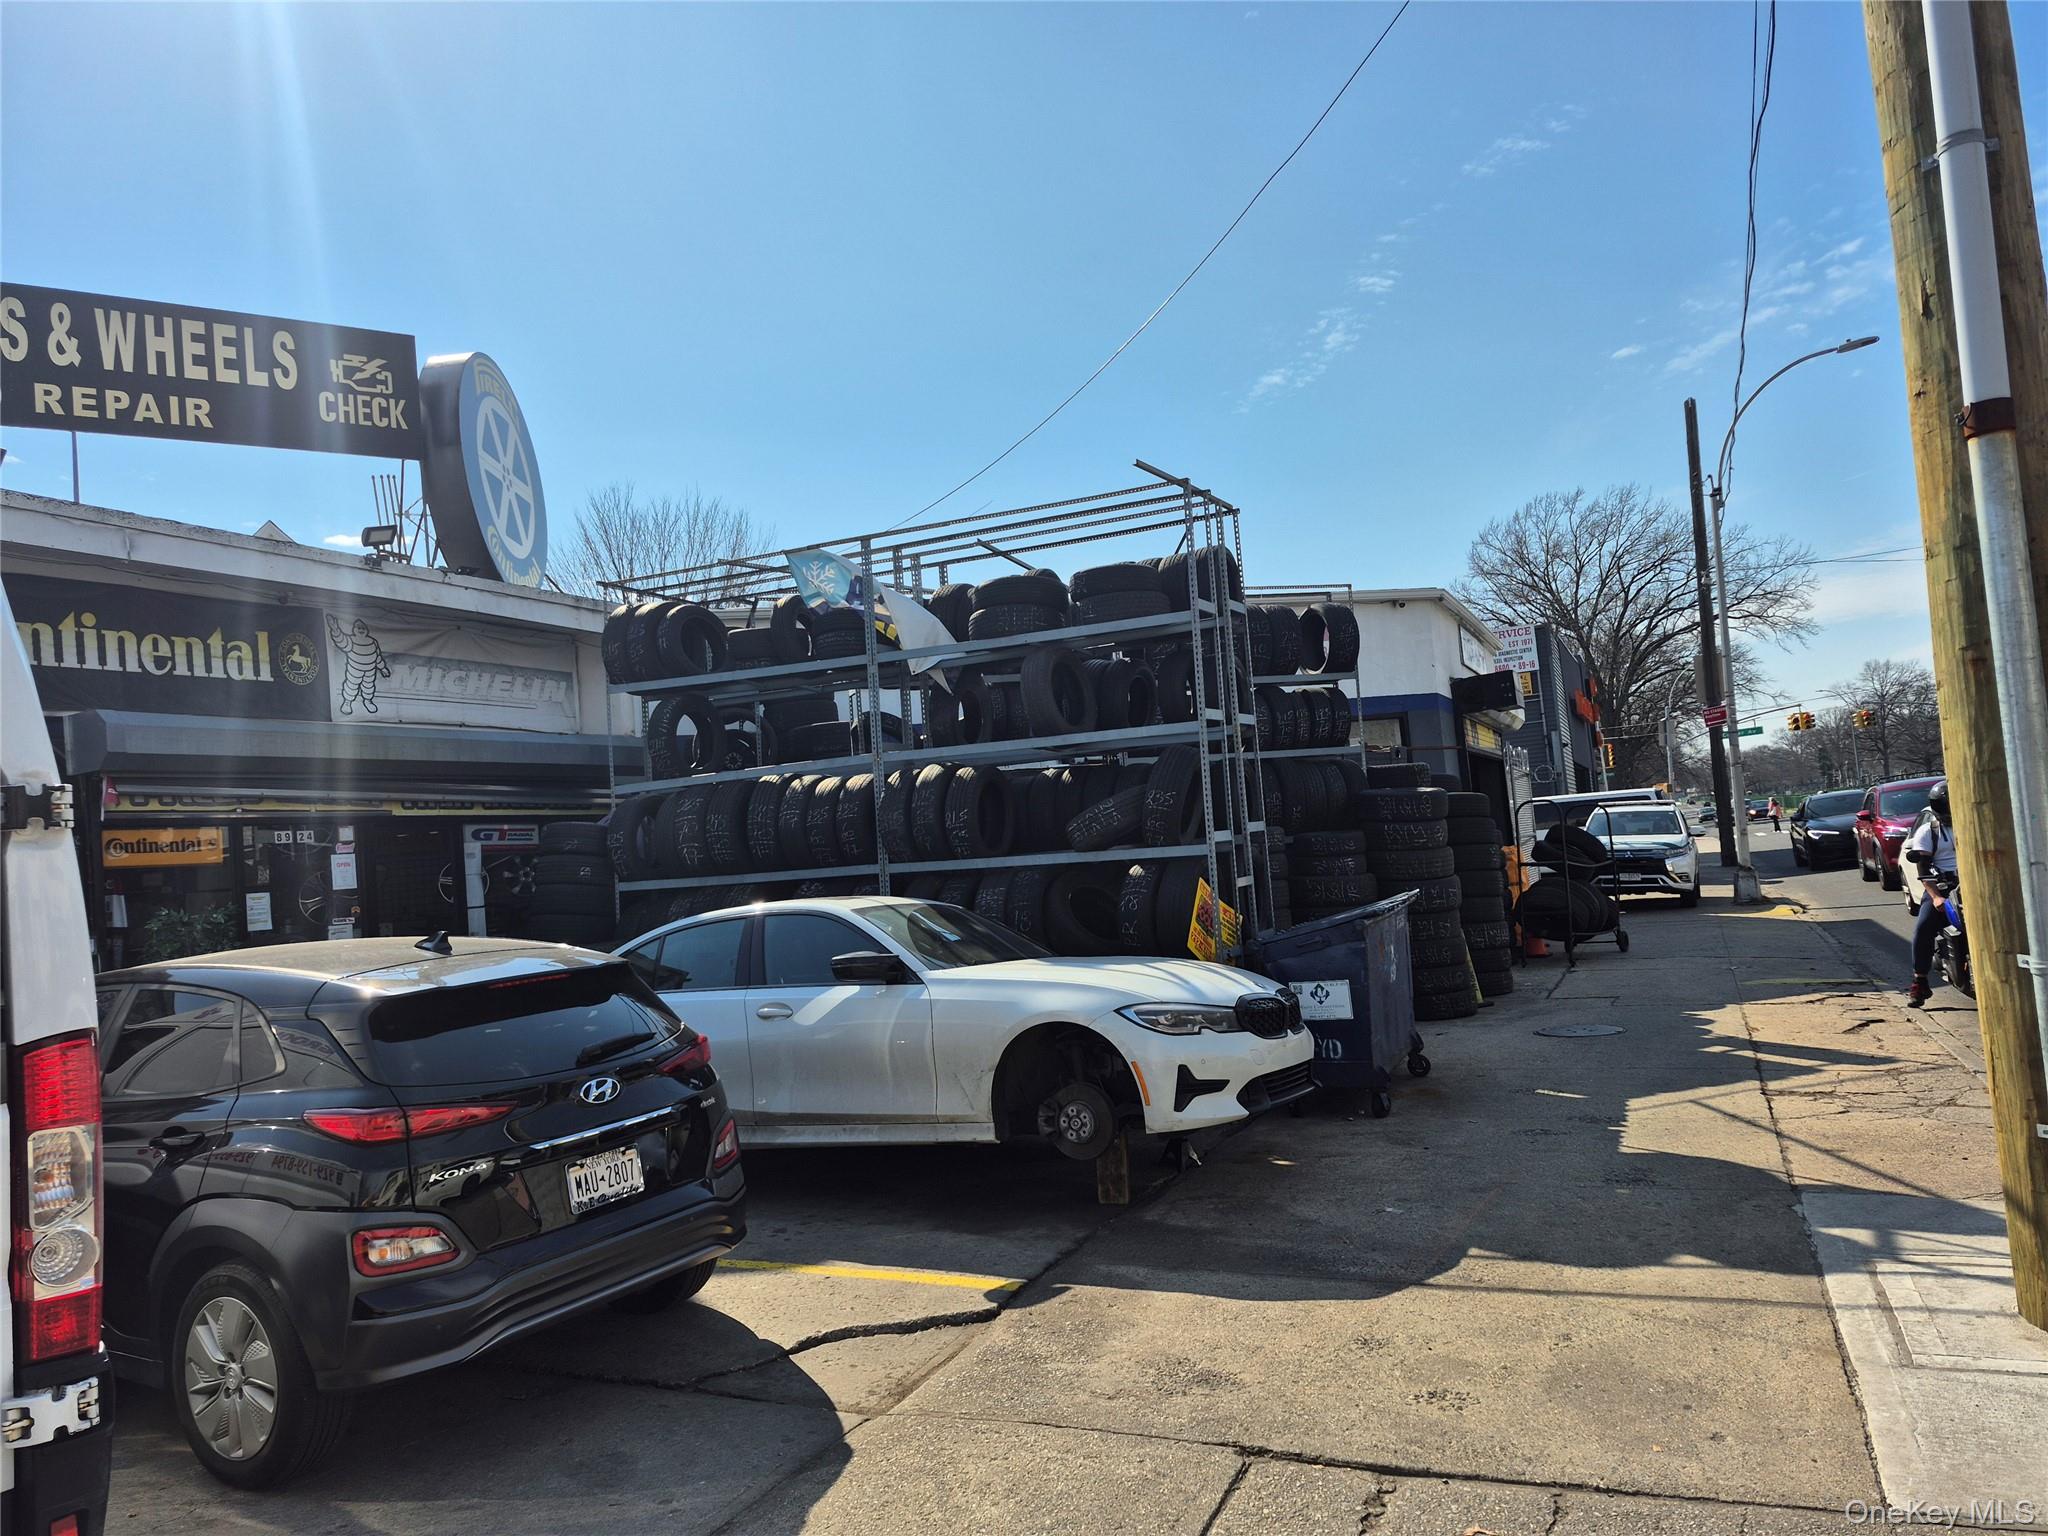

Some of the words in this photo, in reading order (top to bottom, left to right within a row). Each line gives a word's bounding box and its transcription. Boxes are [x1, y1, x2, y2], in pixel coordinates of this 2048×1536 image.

[47, 302, 82, 367] &
[94, 307, 298, 391] WHEELS
[34, 382, 214, 428] REPAIR
[318, 391, 409, 431] CHECK
[16, 610, 274, 683] ntinental
[1493, 626, 1532, 639] RVICE
[397, 664, 568, 702] MICHELIN
[105, 838, 204, 857] Continental
[276, 832, 291, 842] 89
[428, 1163, 487, 1183] KONA
[574, 1169, 600, 1200] MAU
[605, 1158, 635, 1188] 2807
[586, 1157, 602, 1171] NEW
